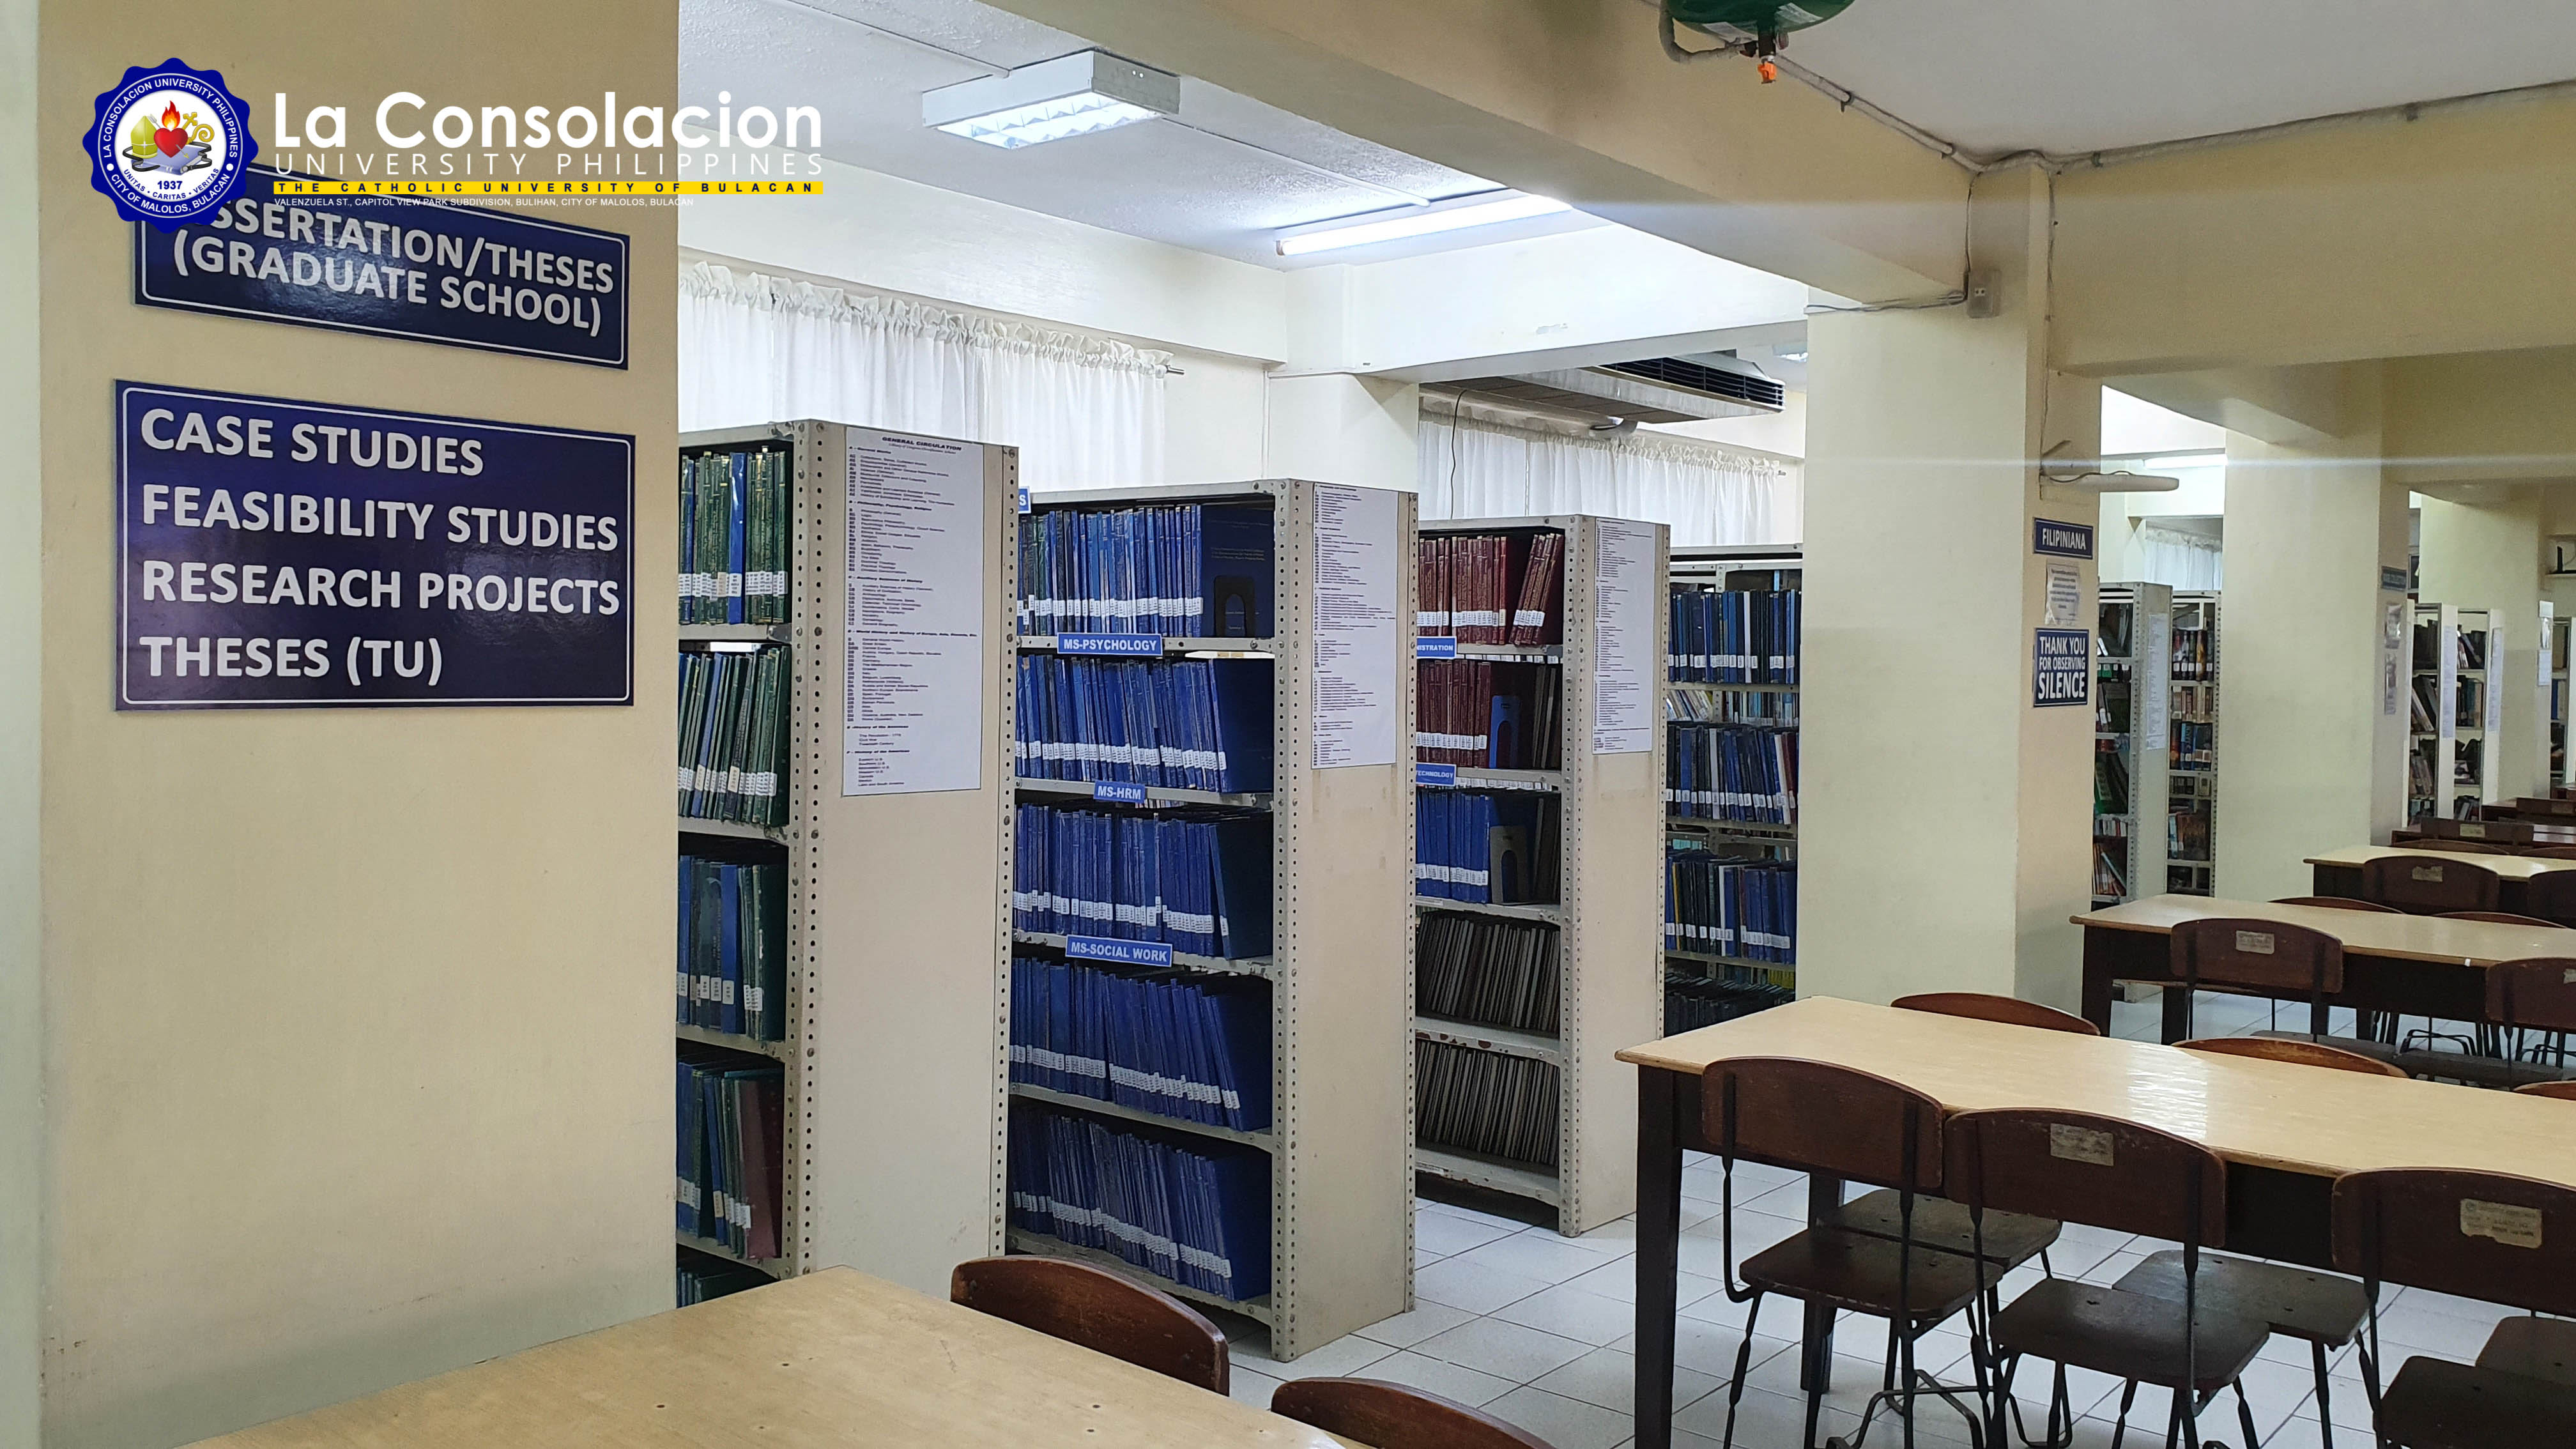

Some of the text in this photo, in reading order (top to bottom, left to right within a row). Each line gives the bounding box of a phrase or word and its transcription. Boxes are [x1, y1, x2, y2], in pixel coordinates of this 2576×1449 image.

[203, 197, 615, 294] SSERTATION/THESES
[174, 229, 601, 337] (GRADUATE SCHOOL)
[141, 408, 484, 476] CASE STUDIES
[882, 436, 914, 446] GENERAL
[916, 441, 962, 451] CIRCULATION
[142, 483, 618, 551] FEASIBILITY STUDIES
[2042, 528, 2087, 550] FILIPINIANA
[142, 560, 620, 615] RESEARCH PROJECTS
[1063, 638, 1157, 651] MS-PSYCHOLOGY
[2039, 636, 2085, 655] THANK YOU
[139, 636, 443, 686] THESES (TU)
[2039, 656, 2085, 671] FOR OBSERVING
[2038, 671, 2085, 700] SILENCE
[1098, 785, 1142, 800] MS-HRM
[1071, 941, 1168, 962] MS-SOCIAL WORK
